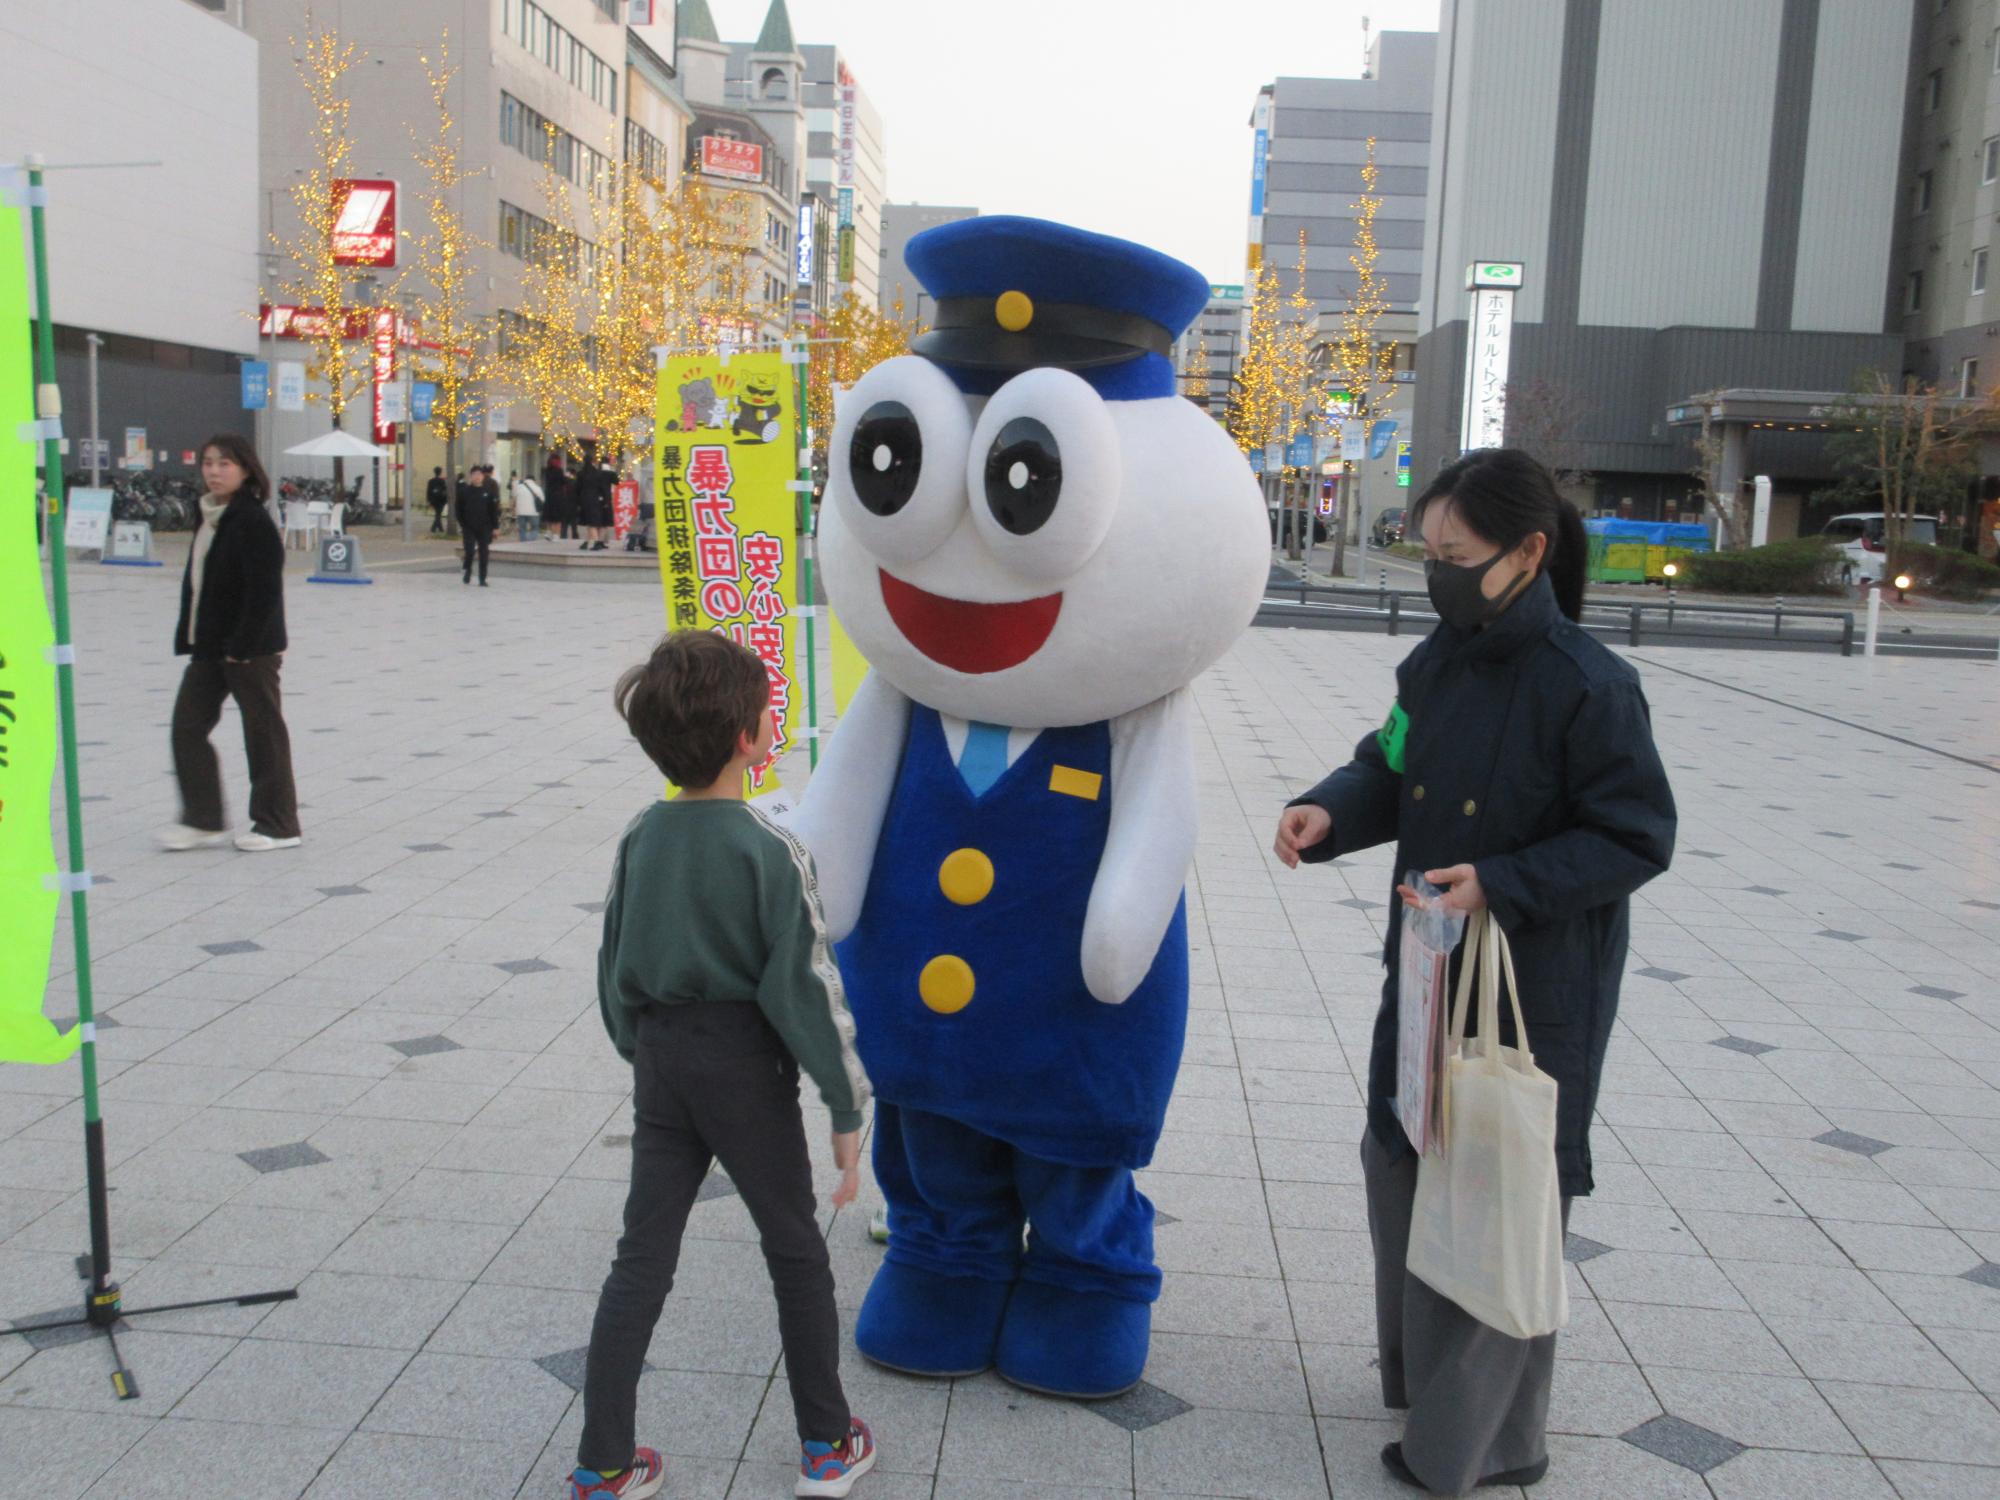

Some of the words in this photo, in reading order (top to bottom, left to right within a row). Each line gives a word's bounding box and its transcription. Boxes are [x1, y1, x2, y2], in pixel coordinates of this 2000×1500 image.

[710, 140, 756, 156] カラオケ
[1485, 294, 1504, 338] ホテル
[1480, 342, 1500, 404] ルートイン
